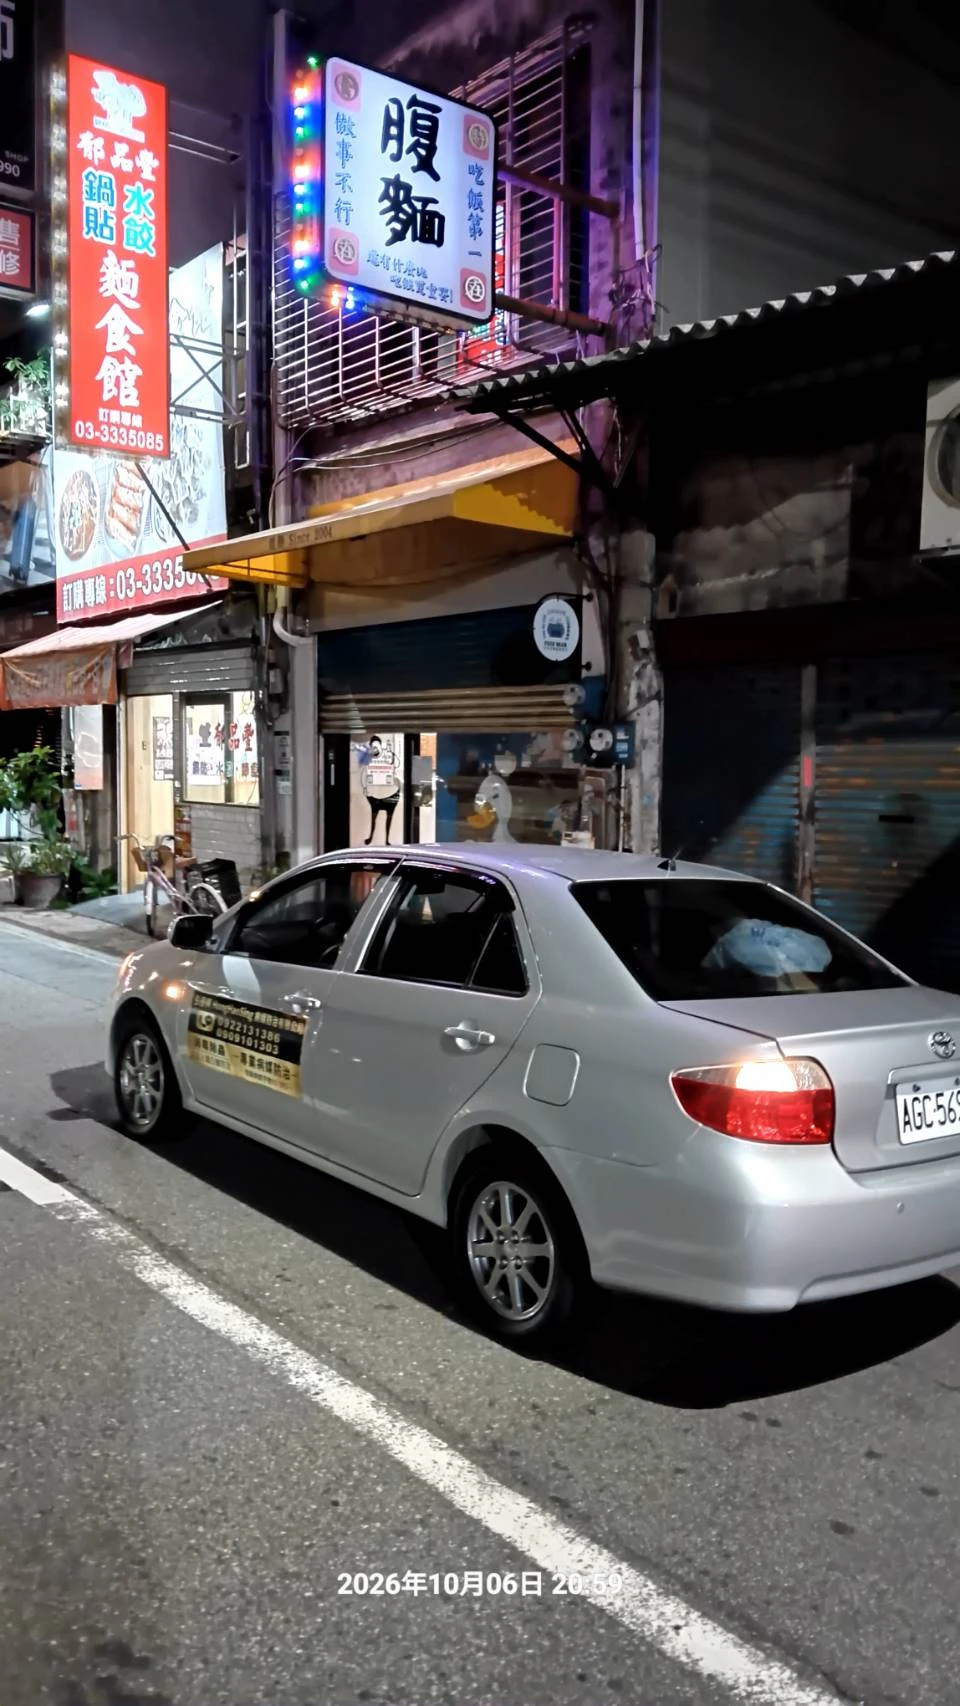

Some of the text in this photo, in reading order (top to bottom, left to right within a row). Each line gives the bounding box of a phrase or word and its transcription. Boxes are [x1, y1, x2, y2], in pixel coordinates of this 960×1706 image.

[83, 169, 115, 243] 鍋貼
[378, 94, 445, 247] 腹麵
[467, 162, 485, 257] 吃飯第一
[123, 184, 156, 255] 水餃
[95, 249, 143, 407] 麵食館
[75, 421, 164, 451] 03-3335085
